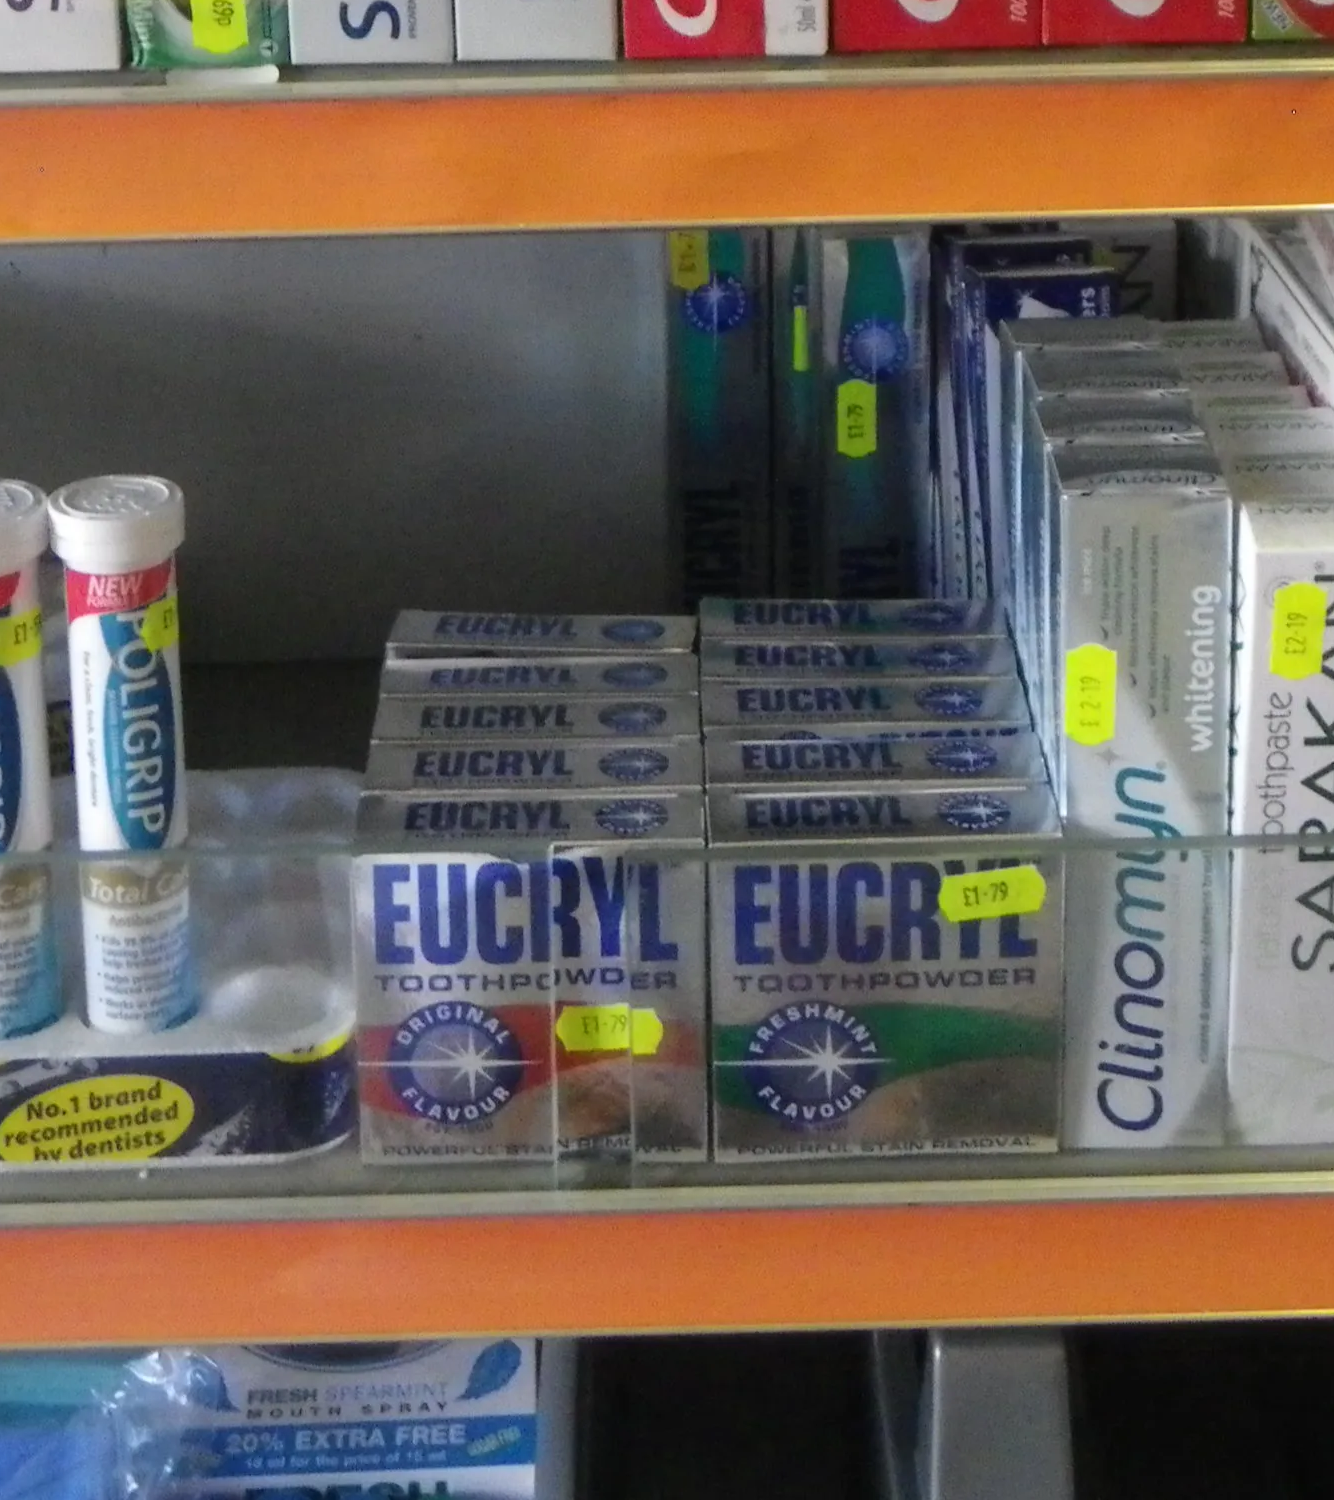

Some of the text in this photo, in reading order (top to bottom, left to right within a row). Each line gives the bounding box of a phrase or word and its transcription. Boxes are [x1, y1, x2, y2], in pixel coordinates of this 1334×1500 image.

[88, 576, 144, 596] NEW
[435, 615, 577, 637] EUCRYL
[431, 667, 576, 686] EUCRYL
[1188, 584, 1222, 753] whitening
[89, 876, 149, 902] Total
[1096, 765, 1186, 1132] Clinomyn
[375, 968, 679, 992] TOOTHPOWDER
[734, 967, 1037, 993] TOOTHPOWDER
[748, 1003, 879, 1055] FRESHMINT
[756, 1082, 869, 1120] FLAVOUR
[860, 1139, 924, 1153] STAIN
[931, 1136, 1037, 1153] REMOVAL
[247, 1383, 448, 1405] FRESH SPEARMINT
[246, 1402, 448, 1420] MOUTH SPRAY
[227, 1424, 466, 1455] 20% EXTRA FREE
